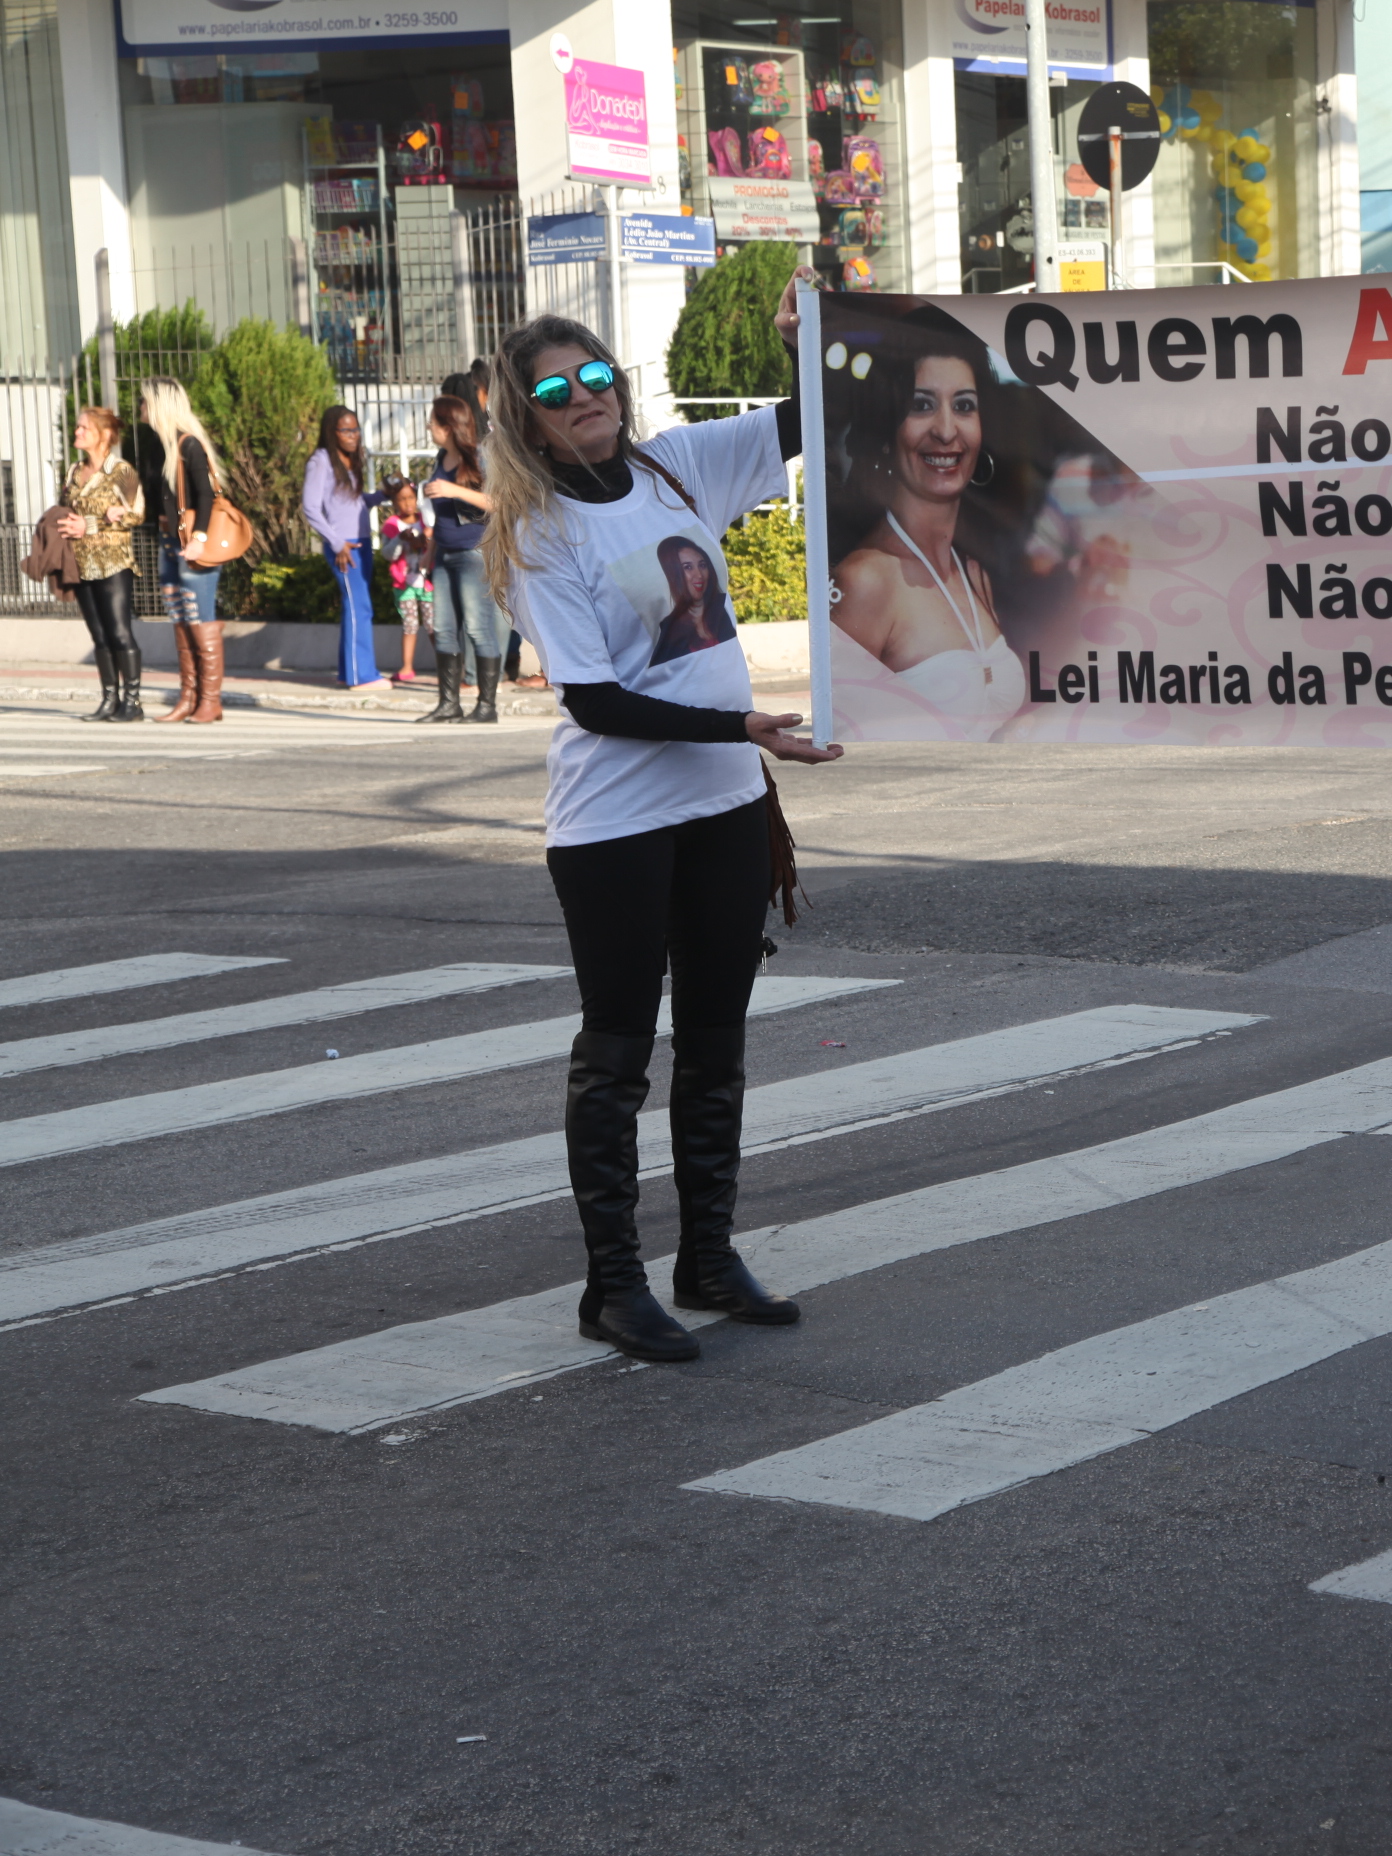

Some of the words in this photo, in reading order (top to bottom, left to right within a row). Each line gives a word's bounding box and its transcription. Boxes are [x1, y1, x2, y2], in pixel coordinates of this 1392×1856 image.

[975, 0, 1026, 18] Papelar
[1045, 2, 1101, 24] Kobrasol
[178, 16, 371, 37] www.papelariakobrasol.com.br
[384, 11, 458, 28] 3259-3500
[733, 184, 789, 199] PROMOÇÃO
[624, 218, 653, 229] Avenida
[530, 239, 545, 249] José
[639, 237, 670, 248] Central)
[665, 230, 695, 241] Martins
[1004, 301, 1303, 392] Quem
[1256, 404, 1392, 463] Não
[1028, 650, 1100, 703] Lei
[1117, 650, 1252, 705] Maria
[1267, 651, 1327, 705] da
